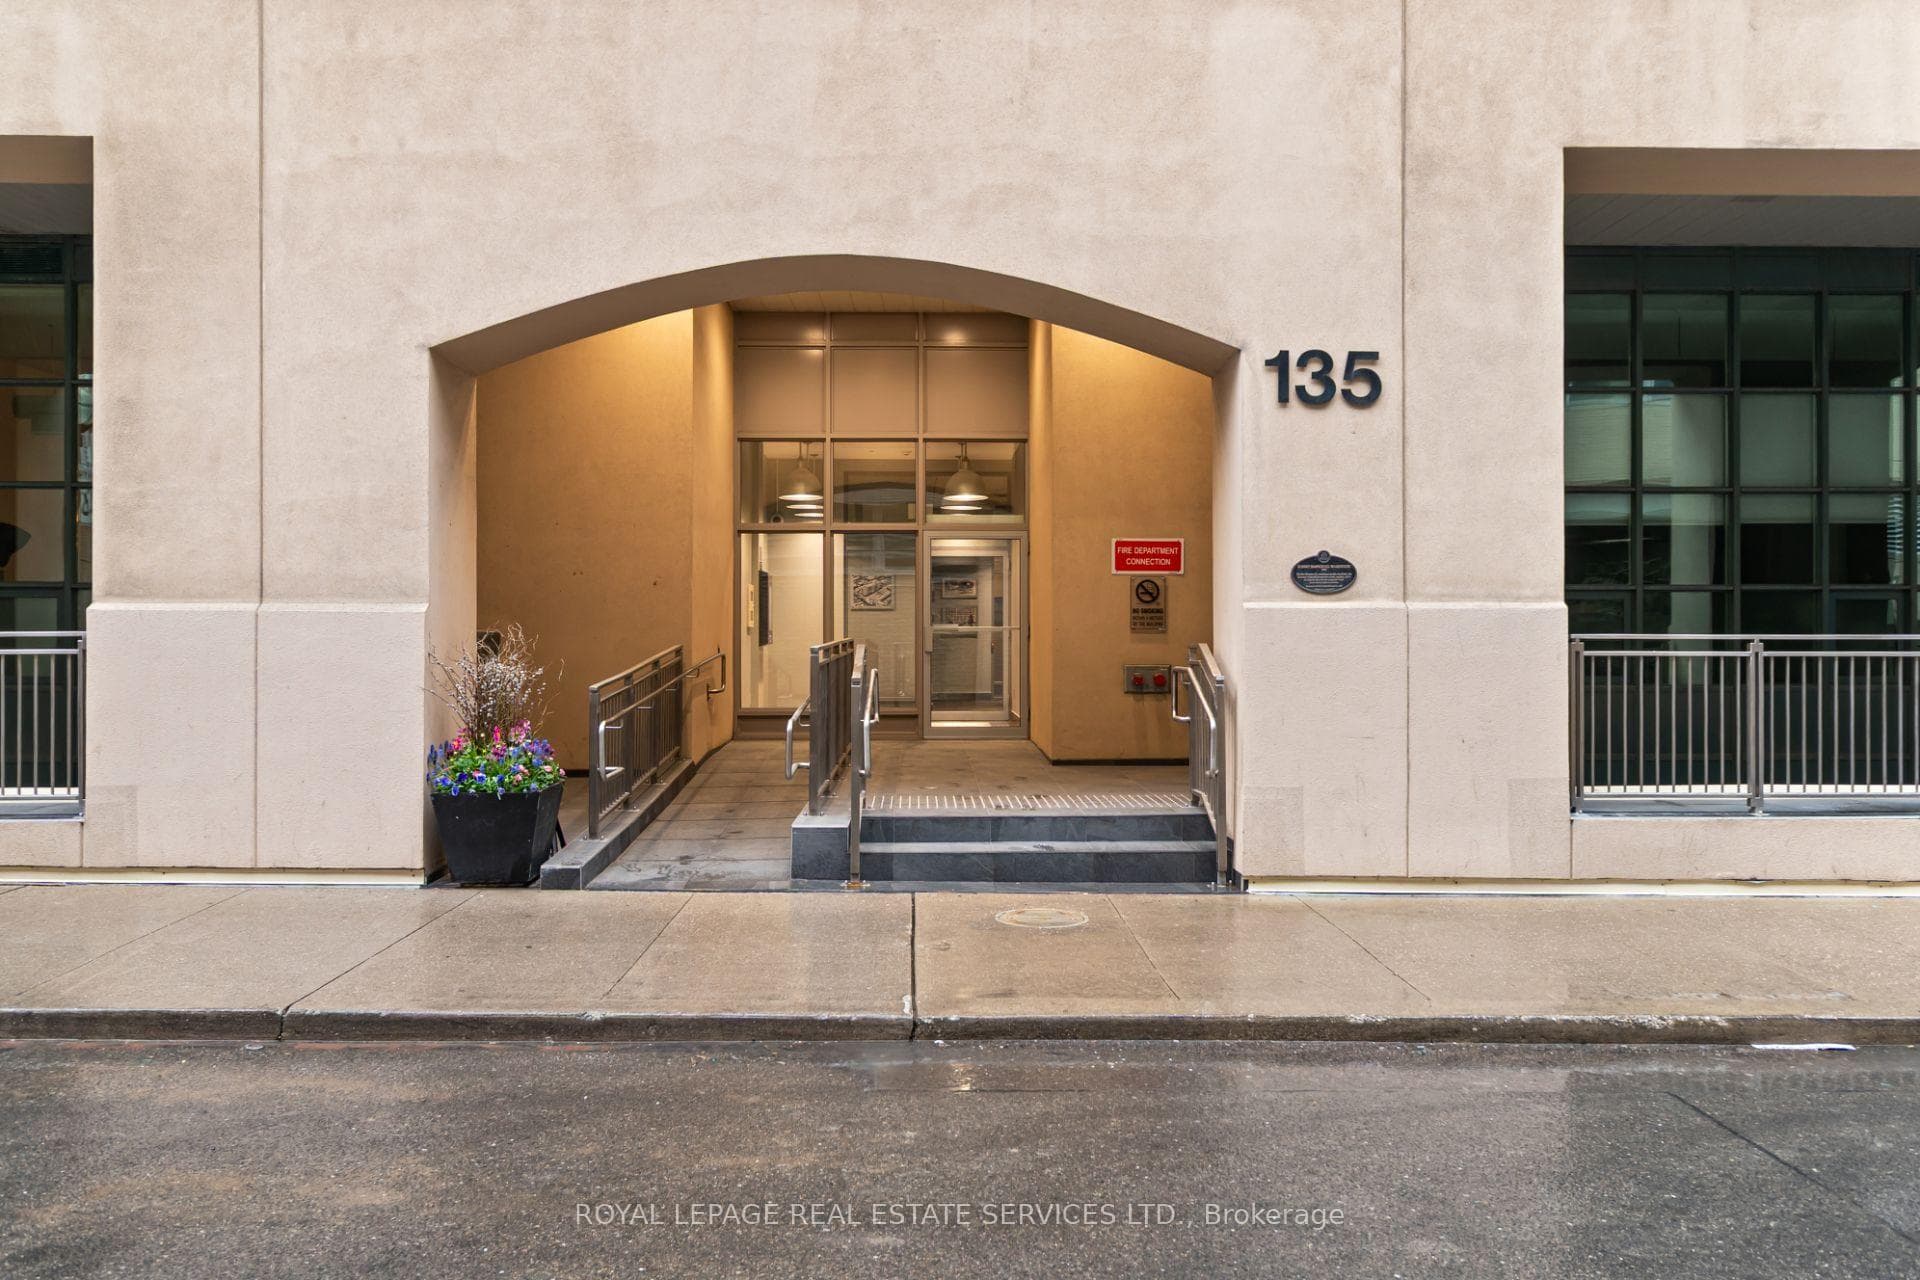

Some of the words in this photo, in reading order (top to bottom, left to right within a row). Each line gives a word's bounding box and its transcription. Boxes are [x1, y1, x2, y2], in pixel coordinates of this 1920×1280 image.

[1265, 349, 1382, 408] 135
[1117, 546, 1133, 554] FIRE
[1134, 546, 1179, 555] DEPARTMENT
[1125, 557, 1171, 566] CONNECTION
